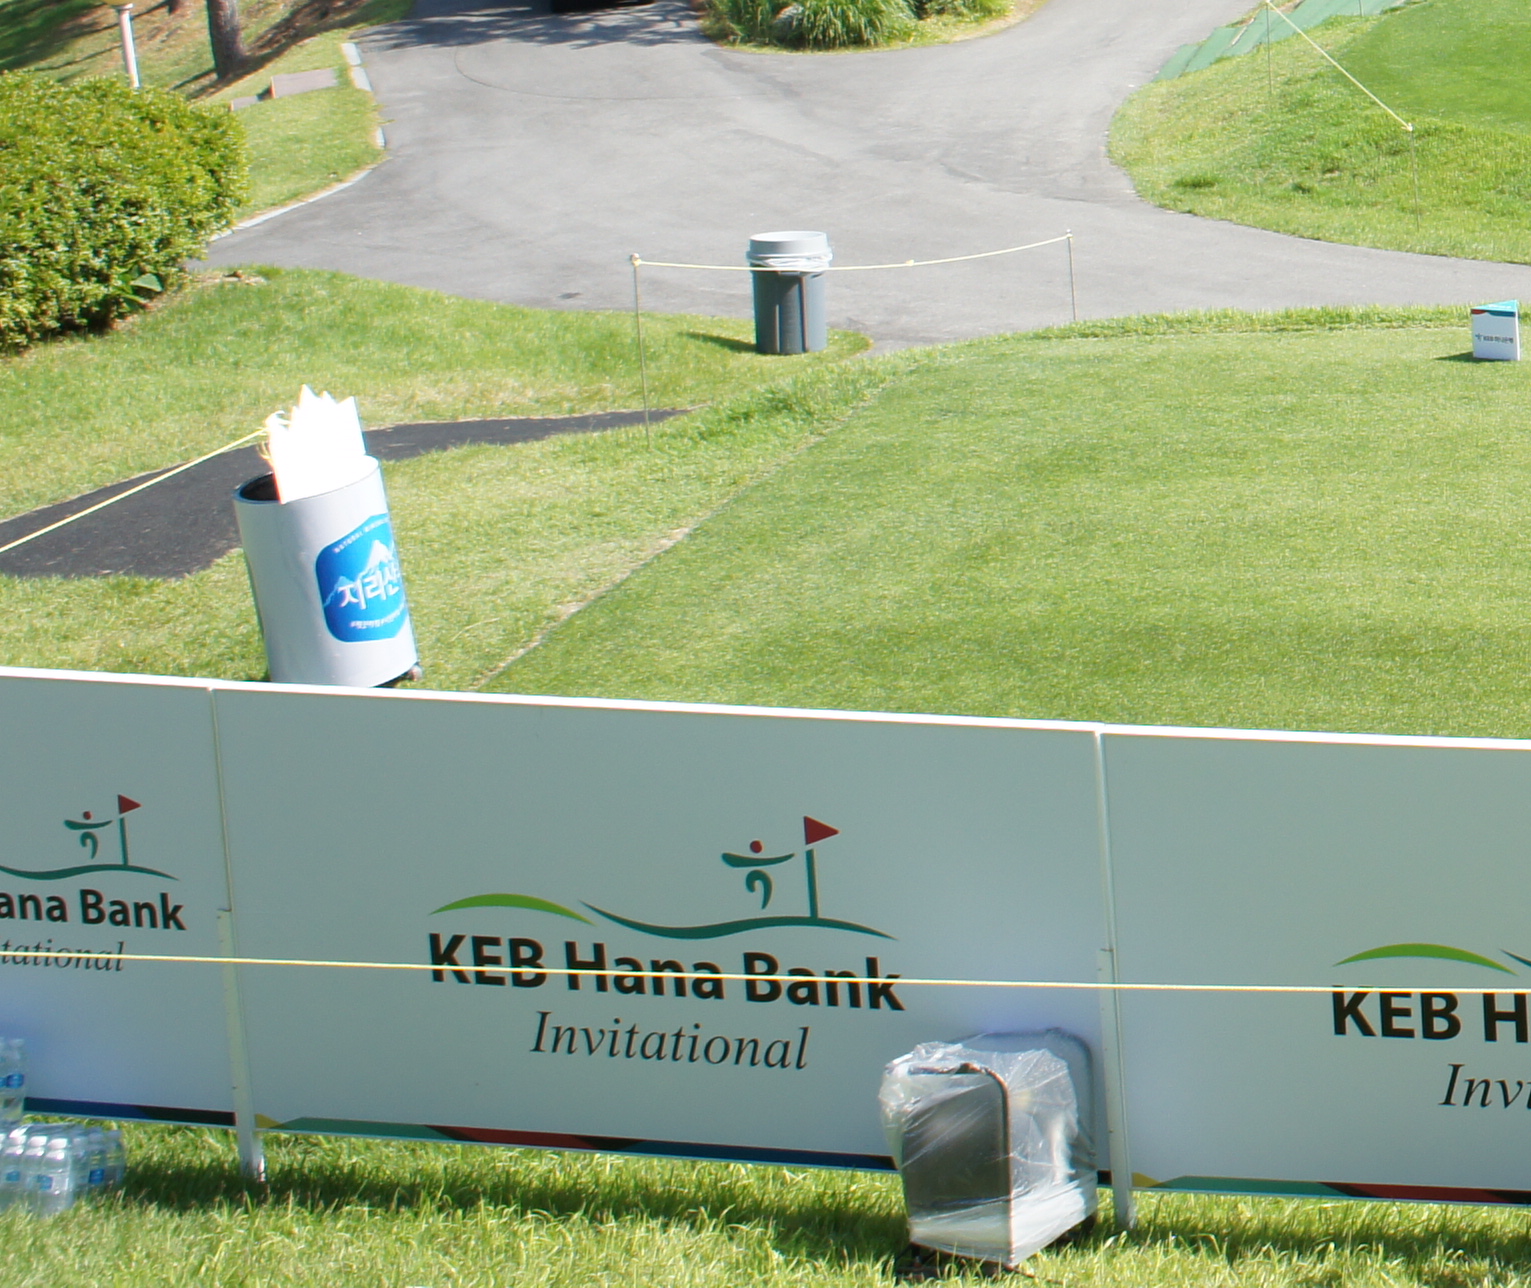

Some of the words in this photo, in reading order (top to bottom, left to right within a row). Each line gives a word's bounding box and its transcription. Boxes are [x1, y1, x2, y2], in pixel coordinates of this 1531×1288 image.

[79, 888, 188, 931] Bank
[428, 932, 548, 989] KEB
[564, 940, 725, 1000] Hana
[742, 951, 907, 1012] Bank
[529, 1010, 811, 1070] Invitational
[1331, 984, 1462, 1041] KEB
